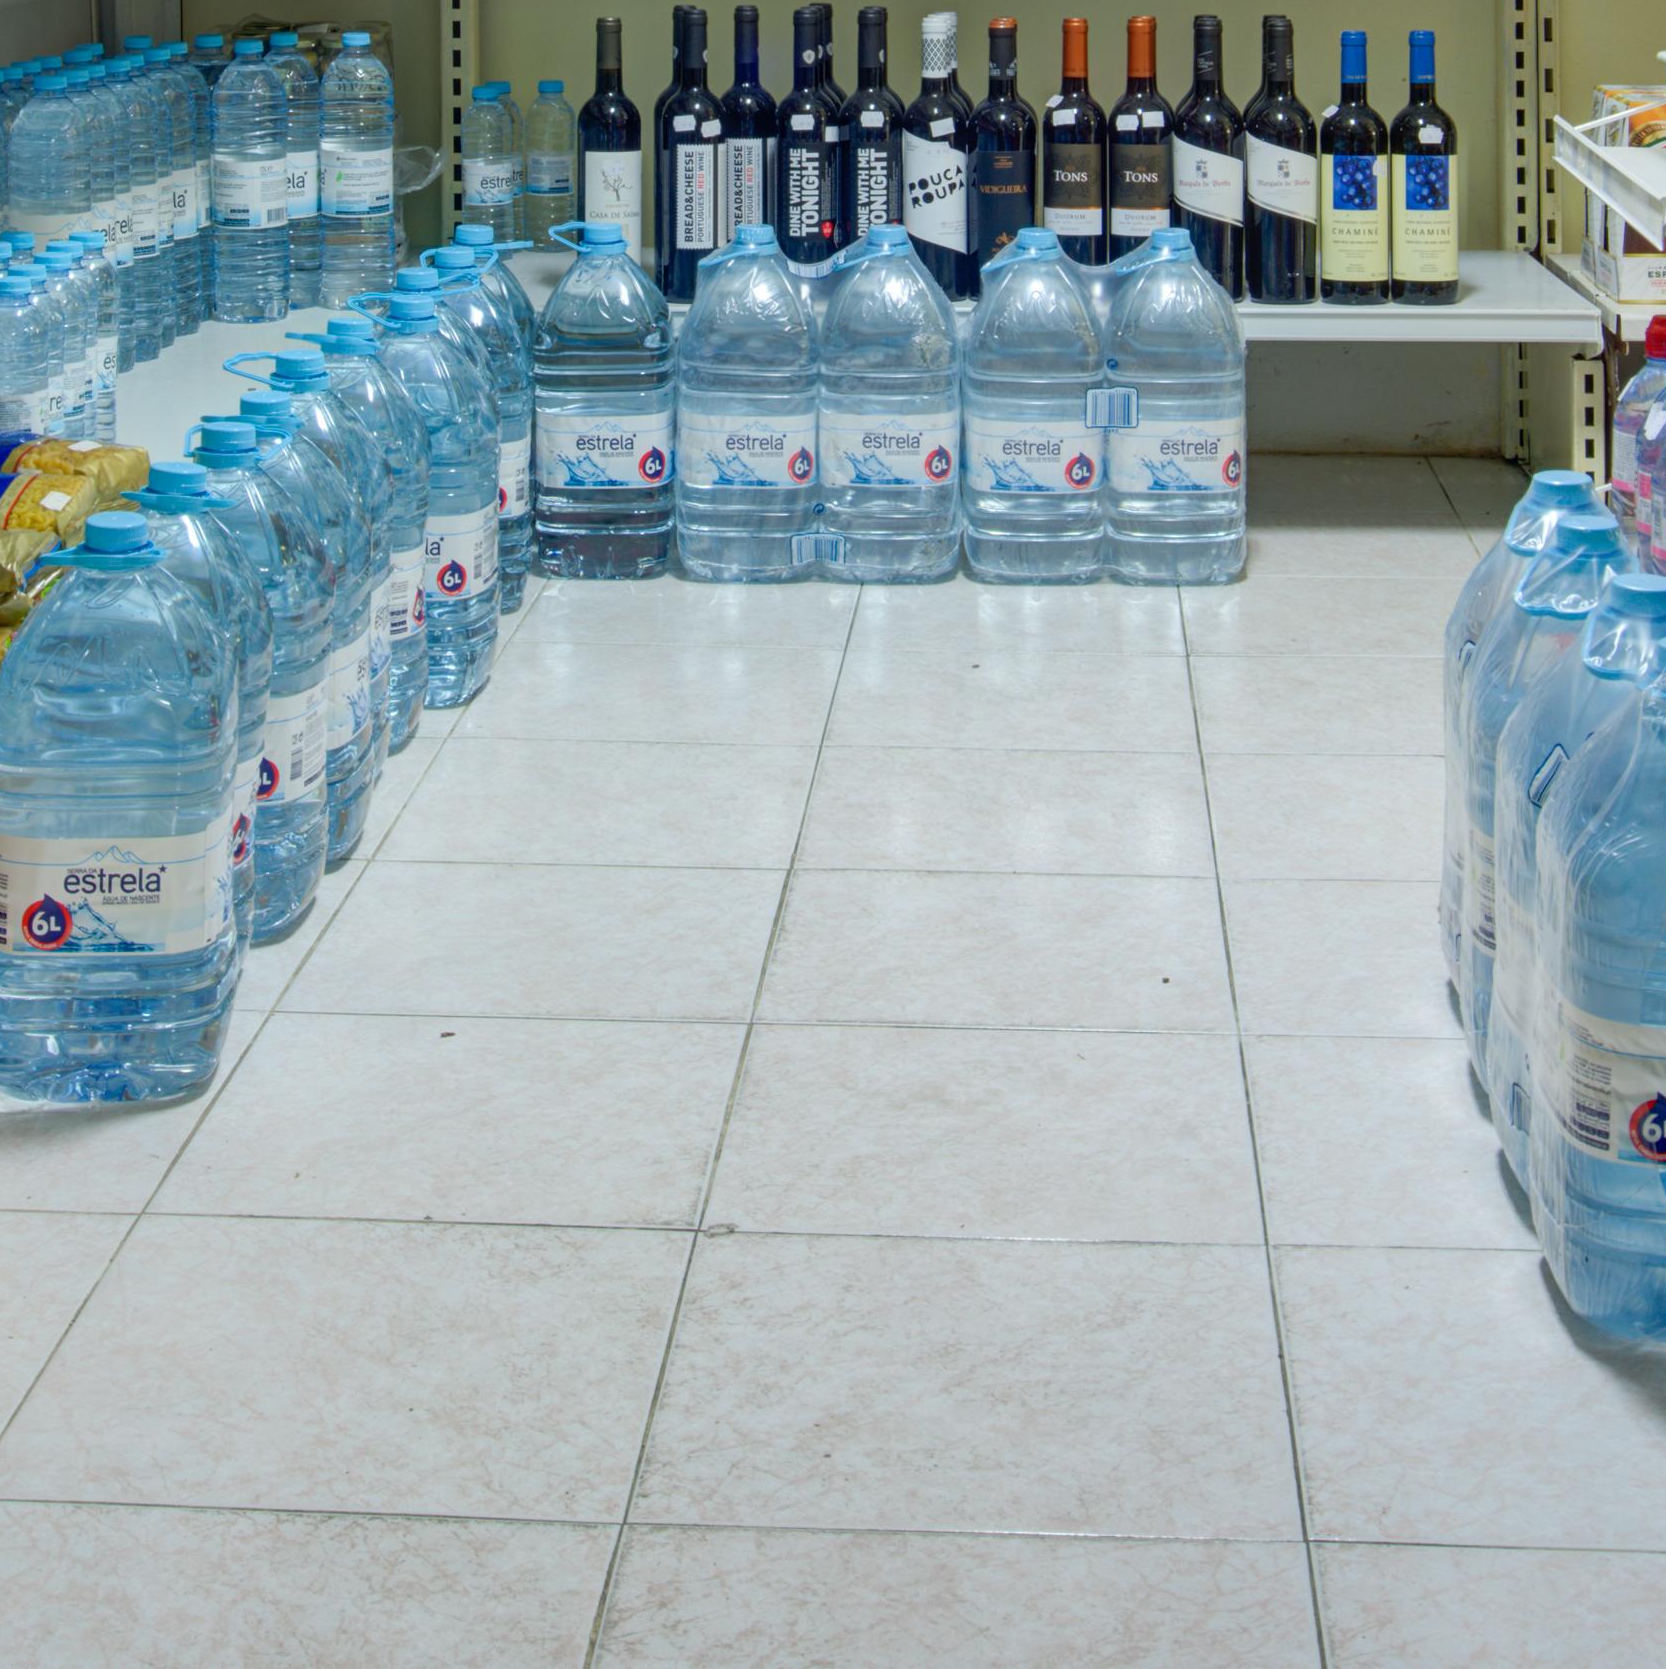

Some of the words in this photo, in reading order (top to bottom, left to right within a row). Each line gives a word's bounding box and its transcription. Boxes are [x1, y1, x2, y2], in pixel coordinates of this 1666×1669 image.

[697, 151, 705, 170] WINE
[697, 172, 705, 189] RED
[907, 166, 964, 195] POUCA
[1053, 169, 1088, 184] TONS
[684, 150, 694, 243] BREAD&CHEESE
[802, 148, 820, 237] TONIGHT
[910, 178, 966, 209] ROUPA
[979, 181, 1028, 196] VIDIGUEIRA
[697, 190, 705, 243] PORTUGUESE
[1333, 225, 1380, 237] CHAMINÉ
[1405, 225, 1451, 237] CHAMINÉ
[1002, 440, 1061, 457] estrela
[1159, 439, 1219, 457] estrela
[63, 867, 161, 894] estrela
[30, 910, 63, 937] 6L
